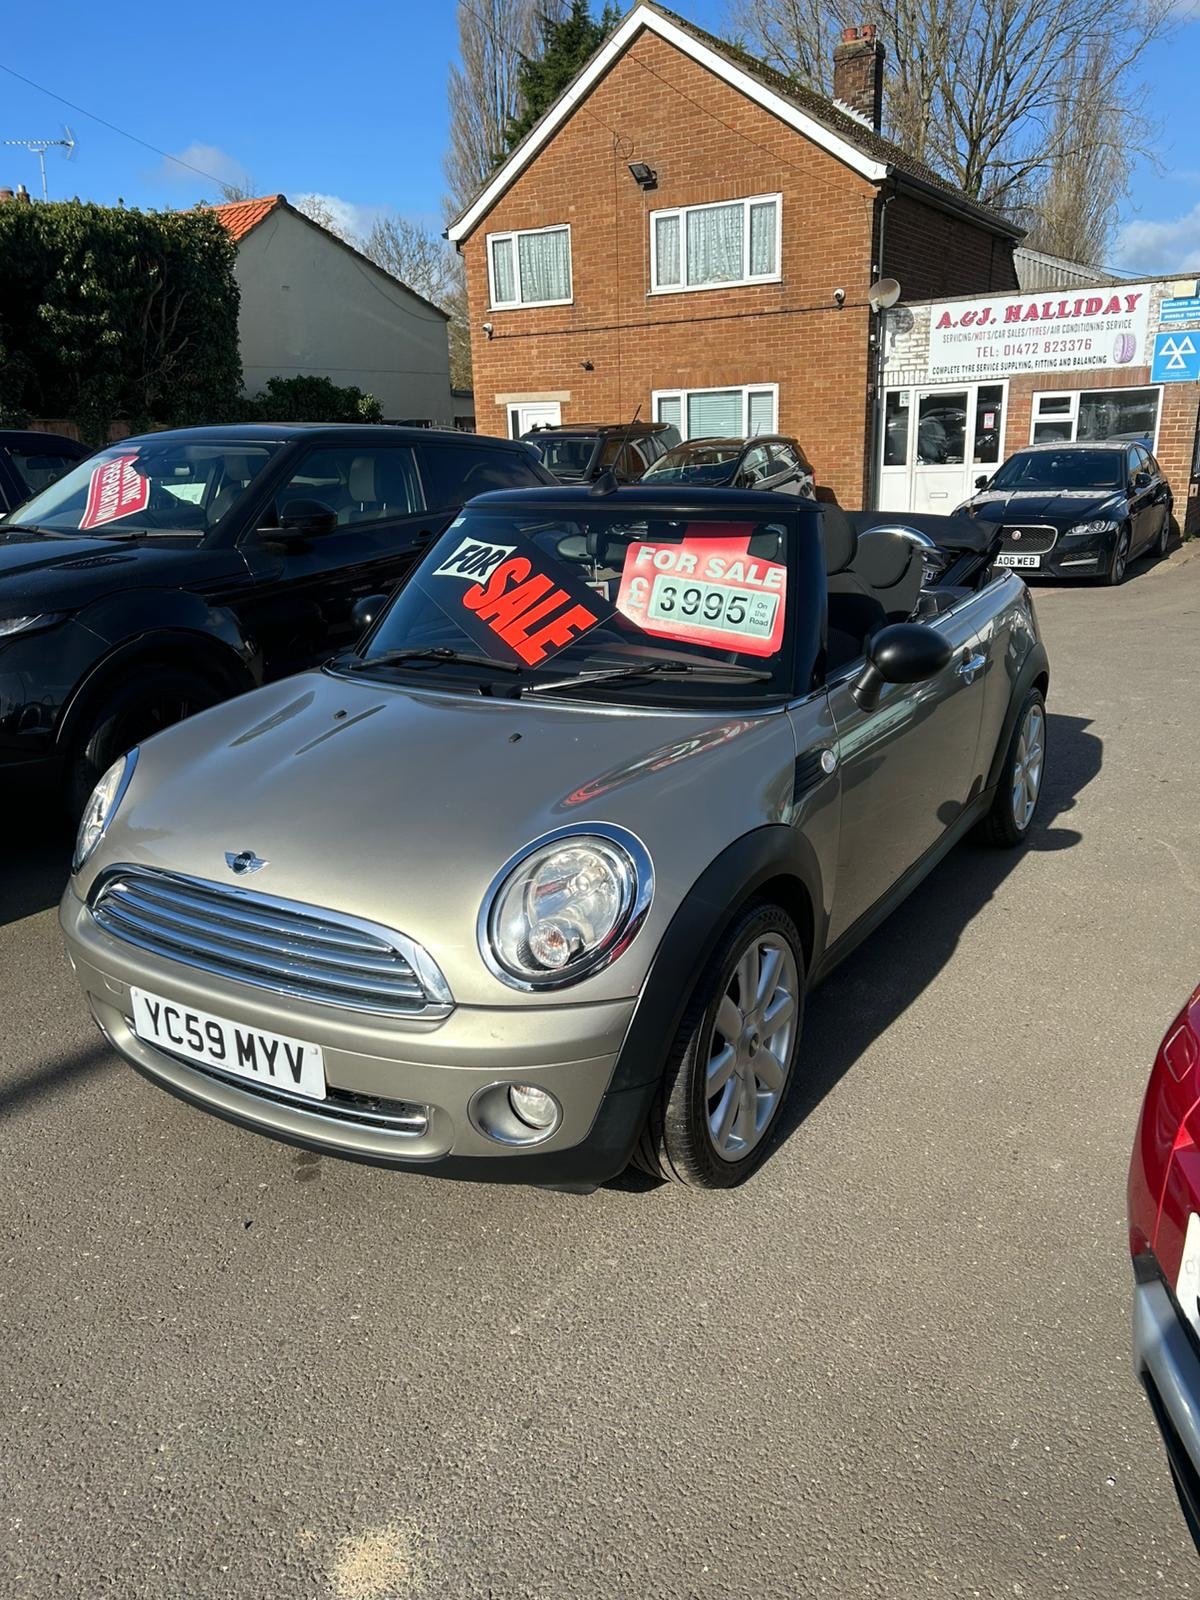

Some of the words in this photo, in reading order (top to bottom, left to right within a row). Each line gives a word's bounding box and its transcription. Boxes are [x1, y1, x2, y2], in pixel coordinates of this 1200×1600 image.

[1003, 293, 1143, 323] HALLIDAY
[1062, 321, 1105, 334] CONDITIONING
[1106, 319, 1132, 330] SERVICE
[976, 345, 999, 358] TEL:
[1003, 342, 1039, 356] 01472
[1044, 338, 1092, 353] 823376
[932, 365, 960, 375] COMPLETE
[961, 364, 975, 373] TYRE
[976, 362, 999, 372] SERVICE
[1034, 358, 1057, 368] FITTING
[1059, 357, 1071, 367] AND
[1072, 355, 1107, 366] BALANCING
[95, 460, 123, 522] PREPARATION
[440, 544, 508, 577] FOR
[635, 545, 698, 574] FOR
[704, 557, 787, 589] SALE
[1017, 556, 1036, 566] WEB
[462, 556, 598, 666] SALE
[754, 610, 767, 618] the
[756, 602, 768, 610] On
[749, 617, 769, 627] Road
[144, 997, 226, 1060] YC59
[234, 1029, 304, 1084] MYV
